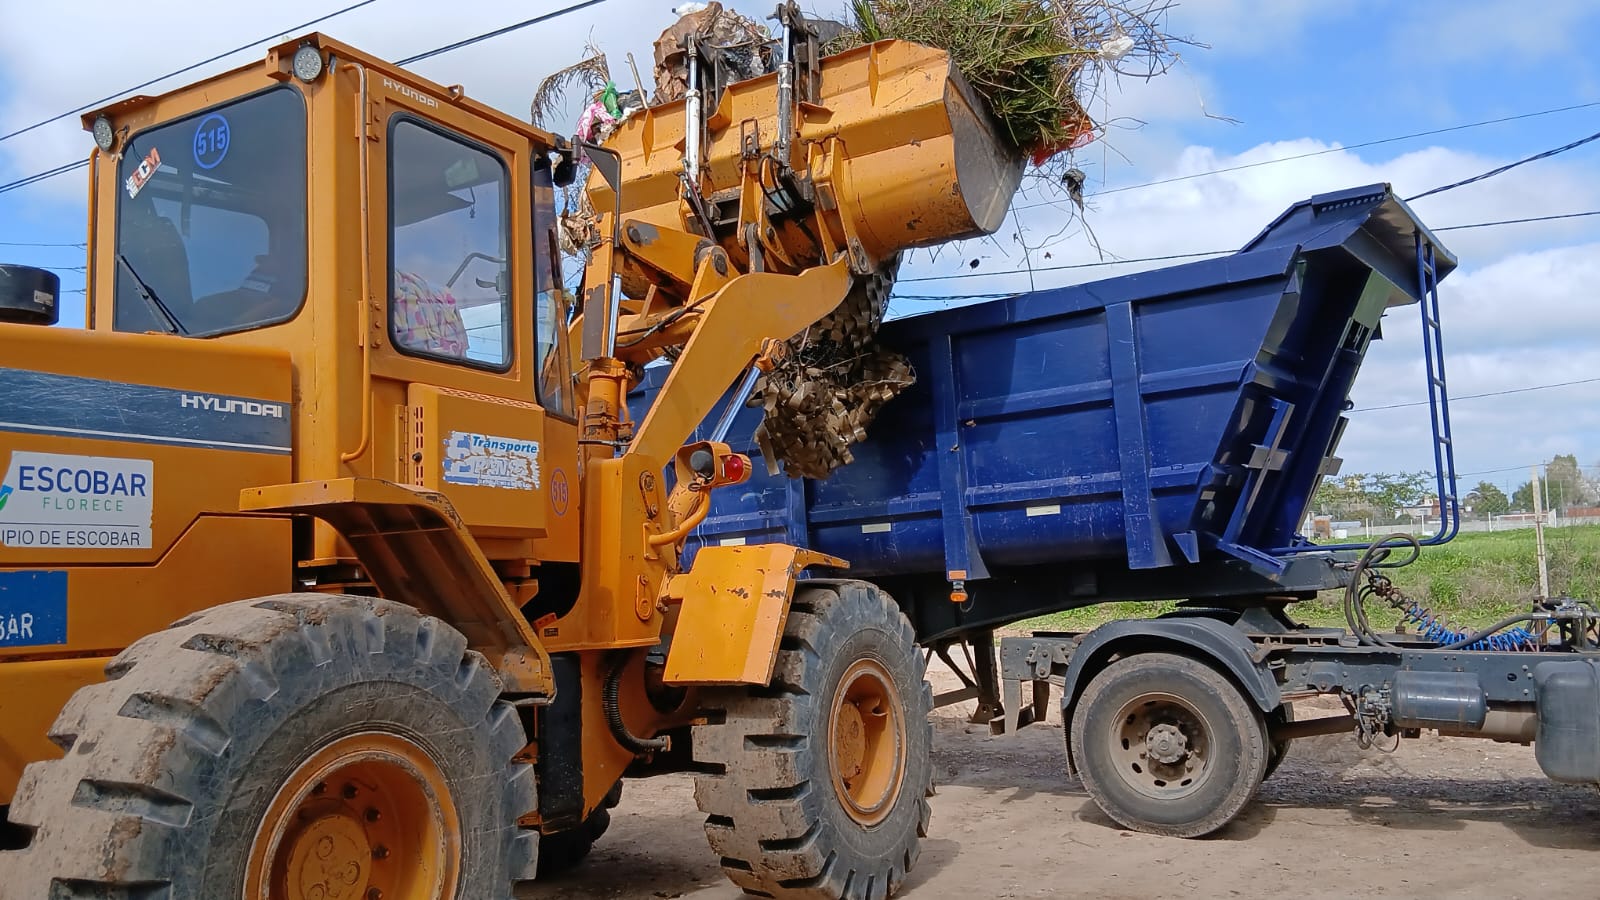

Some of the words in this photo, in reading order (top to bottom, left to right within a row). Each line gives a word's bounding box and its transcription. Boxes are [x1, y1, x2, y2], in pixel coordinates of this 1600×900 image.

[383, 78, 439, 109] HYUNDAI
[198, 126, 226, 156] 515
[181, 394, 283, 417] HYUNDAI
[472, 435, 537, 453] Transporte
[19, 465, 147, 497] ESCOBAR
[42, 497, 124, 512] FLORECE
[40, 530, 61, 545] DE
[66, 530, 141, 546] ESCOBAR
